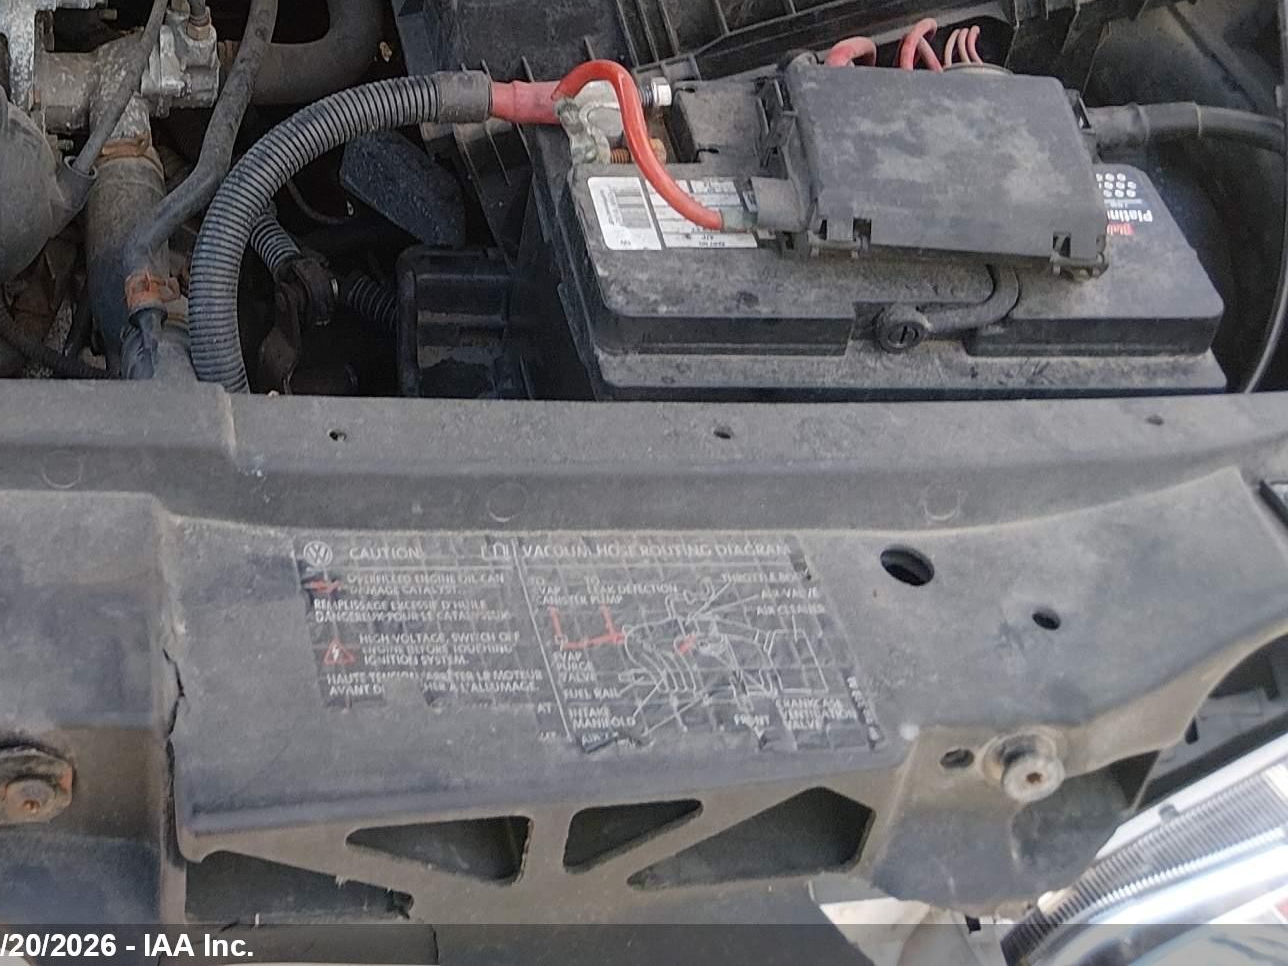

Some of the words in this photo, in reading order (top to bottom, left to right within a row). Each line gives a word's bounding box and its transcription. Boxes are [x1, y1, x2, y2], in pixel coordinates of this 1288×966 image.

[349, 545, 421, 559] CAUTION
[716, 545, 792, 557] DIAGRAM
[359, 633, 389, 645] HIGH
